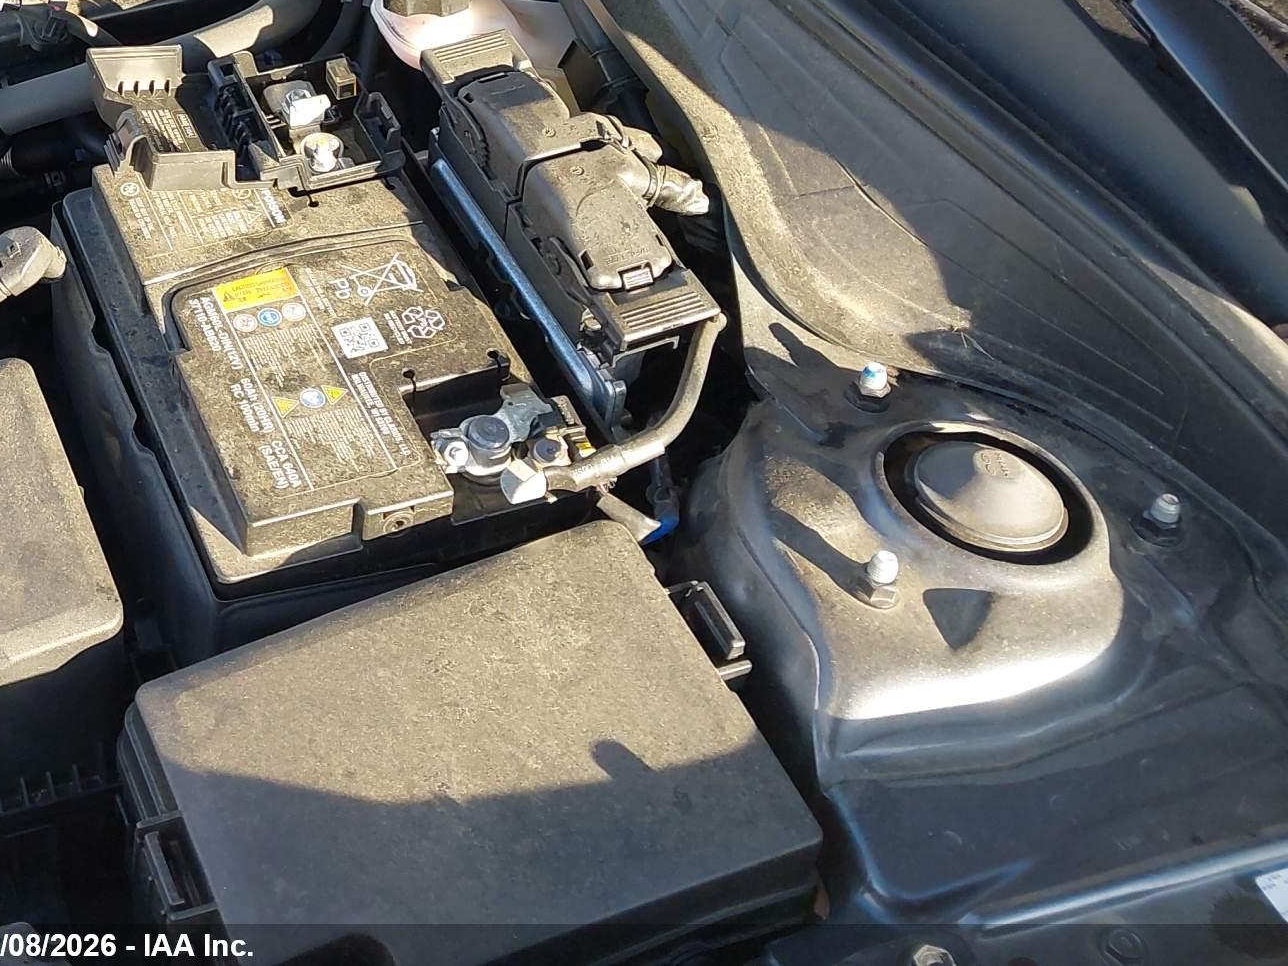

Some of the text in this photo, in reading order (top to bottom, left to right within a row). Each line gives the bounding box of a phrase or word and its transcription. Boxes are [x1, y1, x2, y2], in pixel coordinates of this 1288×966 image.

[329, 278, 351, 299] Pb
[230, 384, 245, 400] RC
[239, 398, 260, 432] 100min
[258, 443, 289, 489] (SAE/EN)
[240, 378, 259, 403] 60Ah
[254, 401, 275, 433] (20HR)
[272, 440, 291, 461] CCA
[282, 462, 303, 488] 640A
